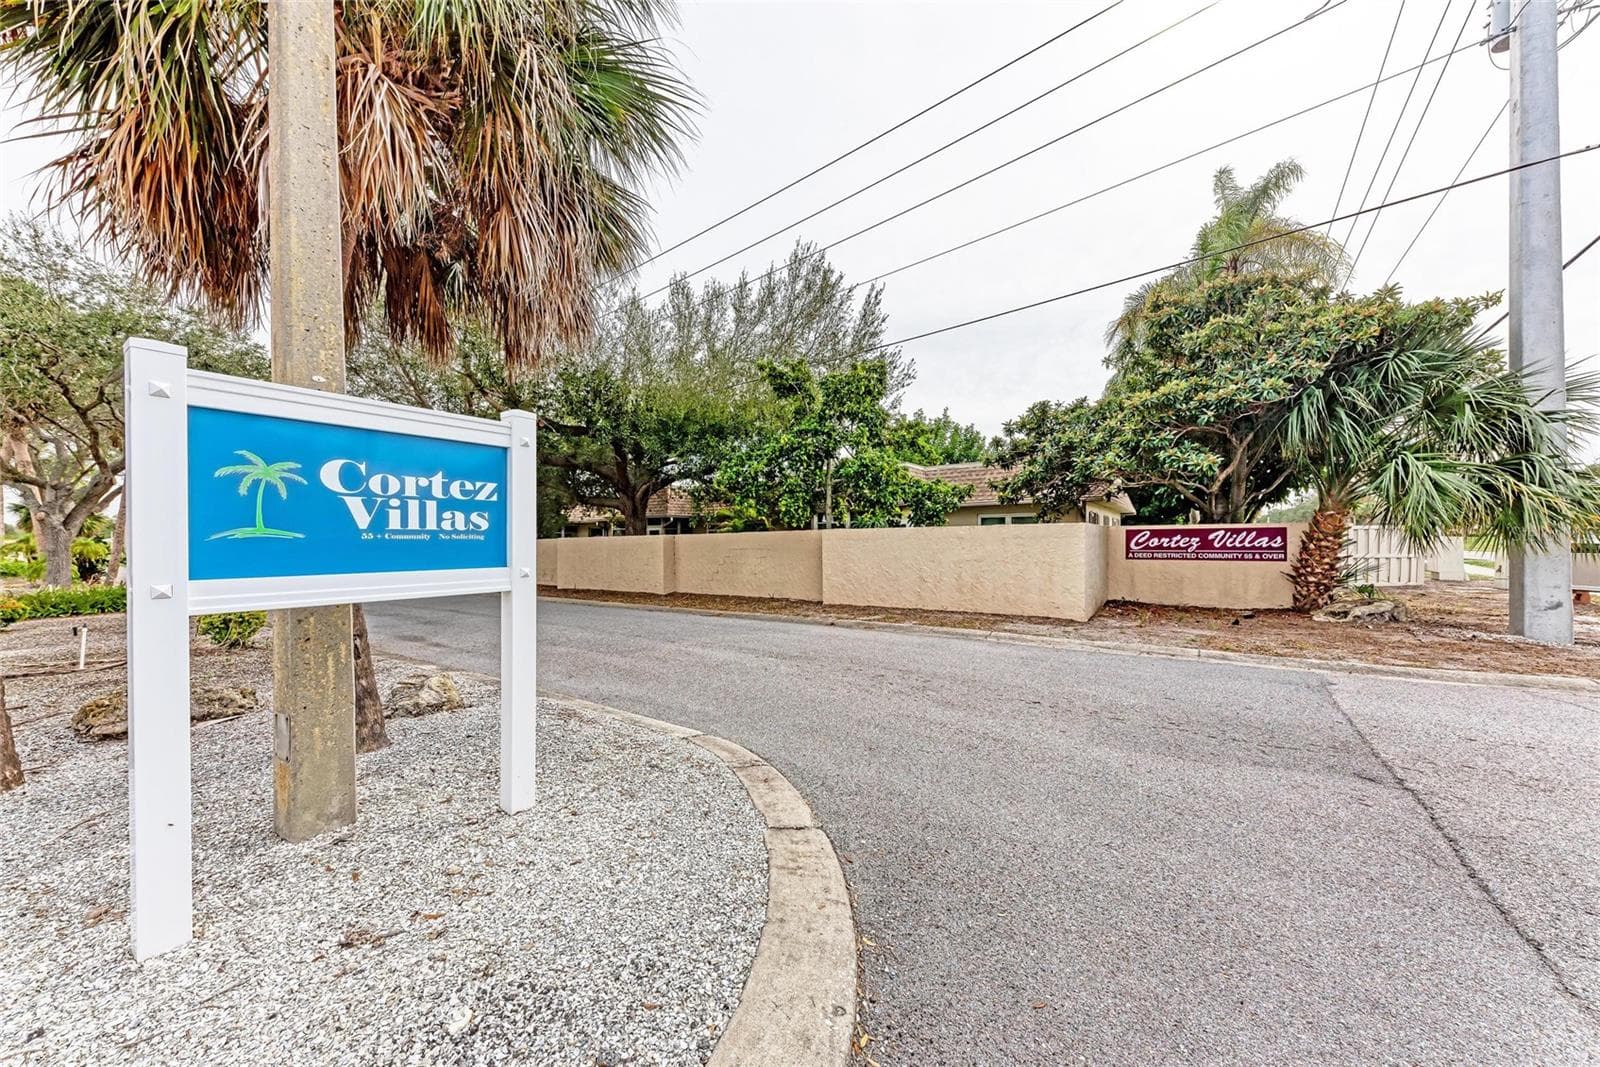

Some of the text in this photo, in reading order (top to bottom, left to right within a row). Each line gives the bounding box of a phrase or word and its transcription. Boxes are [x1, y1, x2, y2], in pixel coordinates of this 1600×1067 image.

[319, 459, 498, 501] Cortez
[337, 496, 489, 531] Villas
[361, 532, 374, 540] 55
[384, 532, 431, 541] Community
[451, 533, 485, 541] Soliciting
[1129, 530, 1284, 552] Cortez Villas
